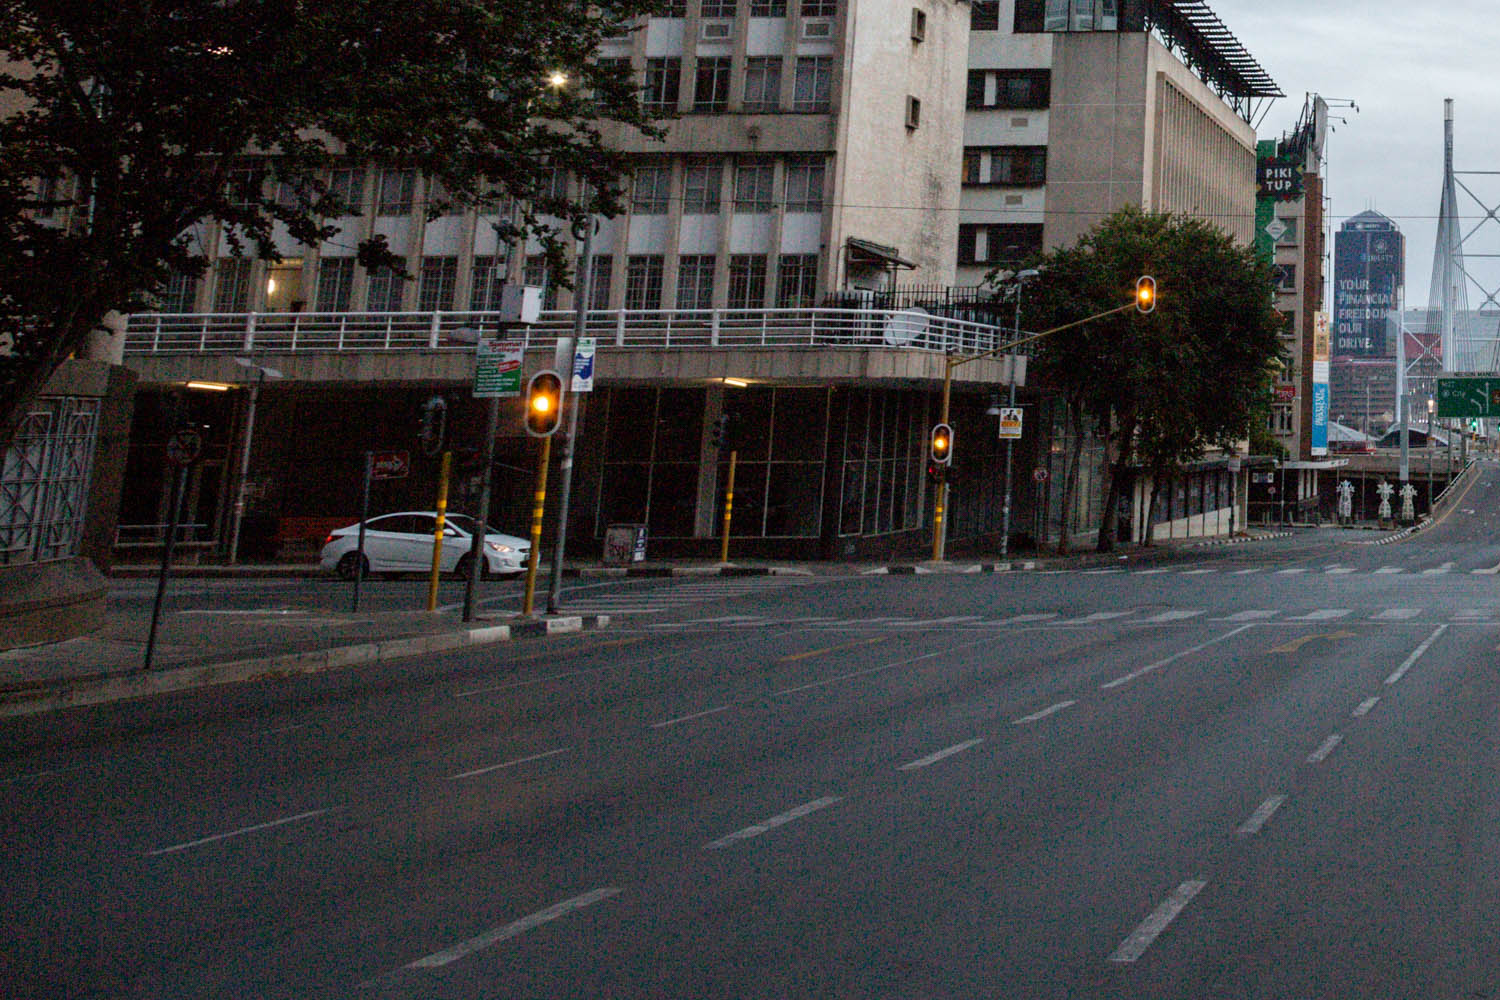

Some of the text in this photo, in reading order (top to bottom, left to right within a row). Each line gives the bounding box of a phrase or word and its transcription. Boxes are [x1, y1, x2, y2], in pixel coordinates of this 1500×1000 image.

[1266, 168, 1291, 179] PIKI
[1266, 181, 1291, 192] TUP
[1338, 279, 1370, 290] YOUR
